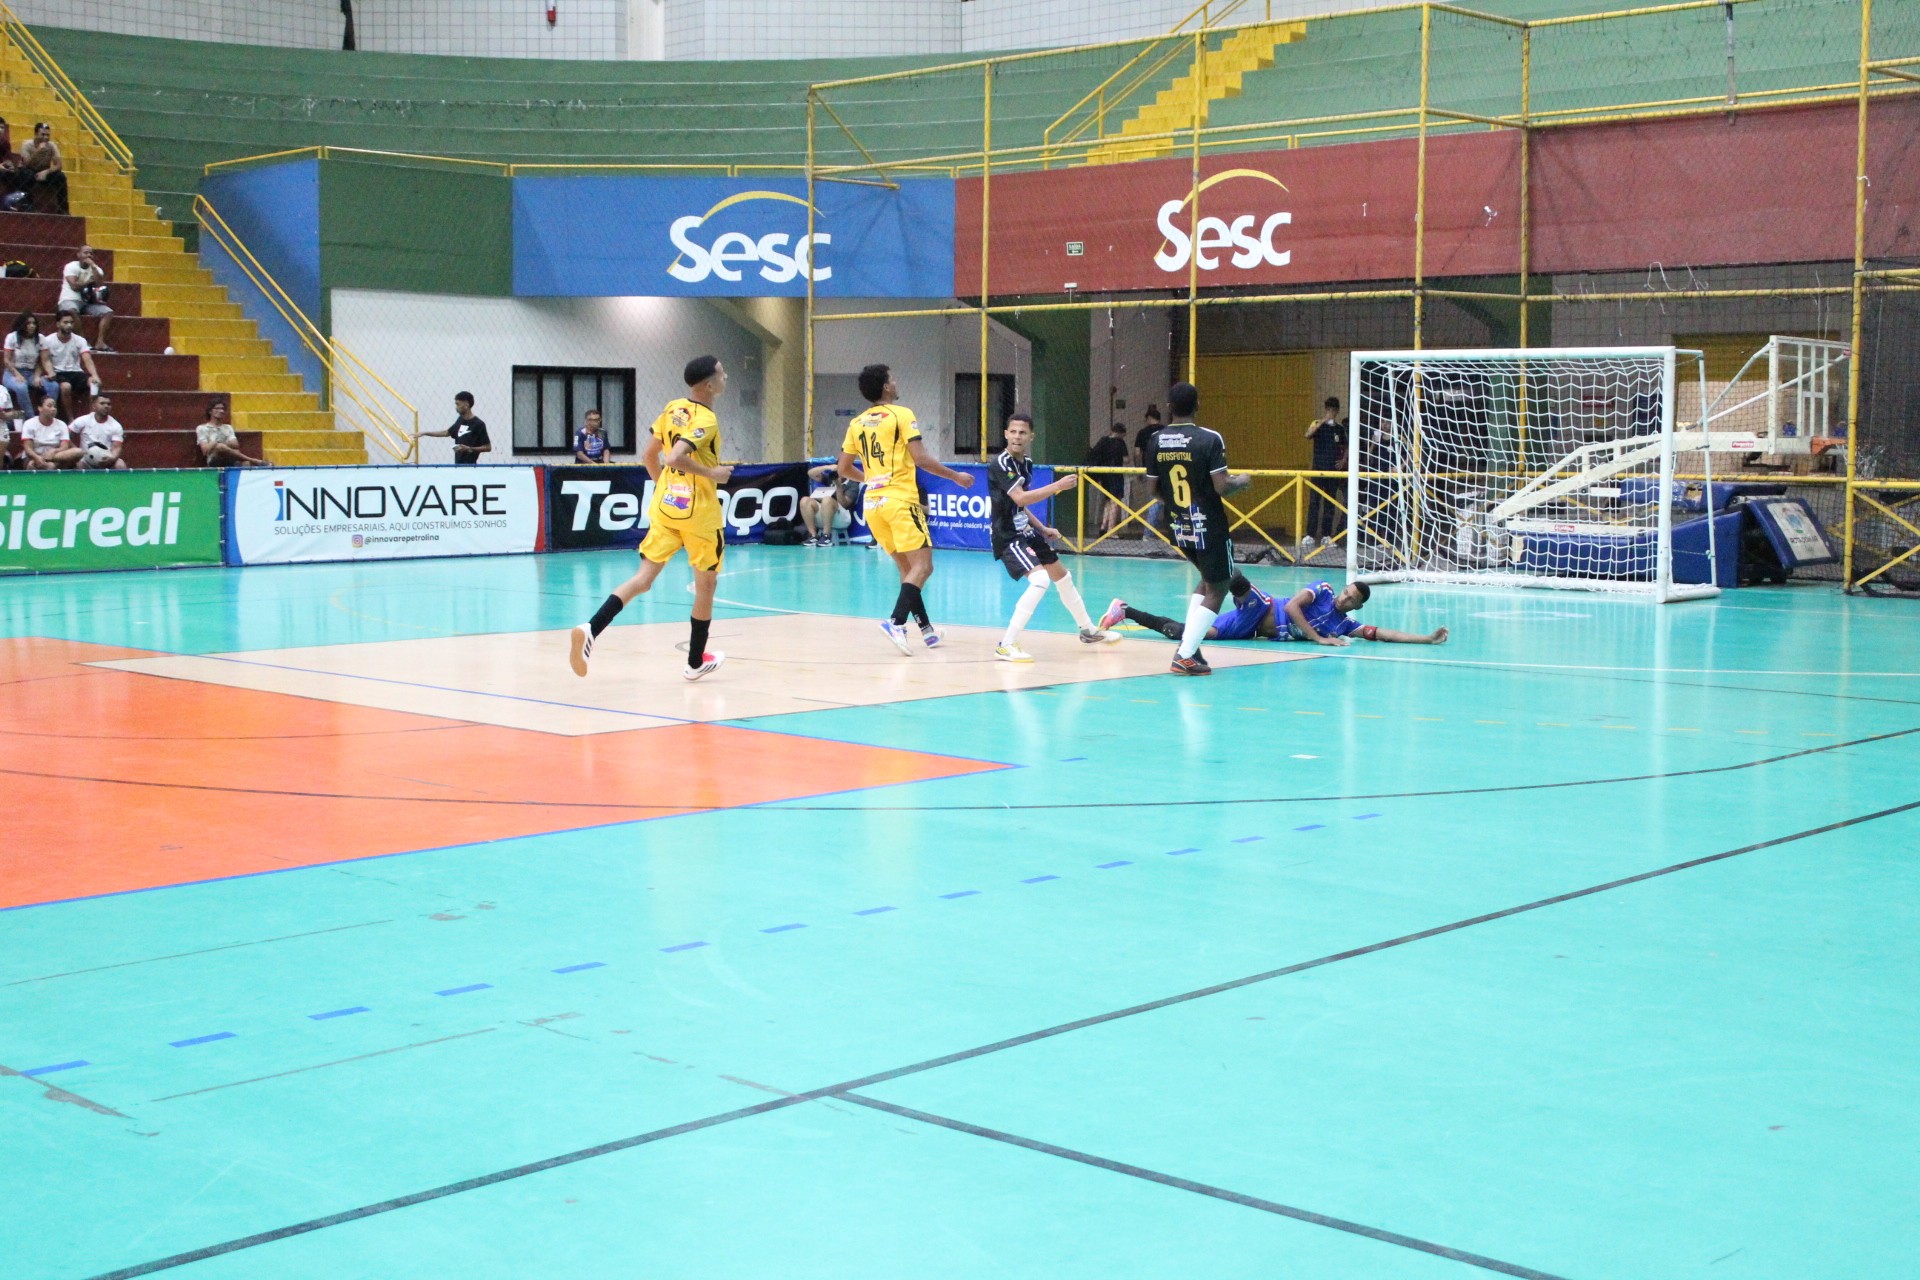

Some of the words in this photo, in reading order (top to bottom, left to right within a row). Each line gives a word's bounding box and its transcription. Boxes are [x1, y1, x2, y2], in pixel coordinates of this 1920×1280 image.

[667, 215, 832, 283] Sesc
[1154, 199, 1292, 272] Sesc
[858, 431, 885, 469] 14
[1169, 464, 1191, 508] 6
[927, 493, 992, 519] ELECO
[274, 523, 322, 536] SOLUÇÕES
[324, 522, 387, 533] EMPRESARIAIS,
[389, 521, 411, 532] AQUI
[412, 519, 472, 531] CONSTRUÍMOS
[474, 519, 507, 529] SONHOS
[364, 533, 440, 545] @innovarepetrolina
